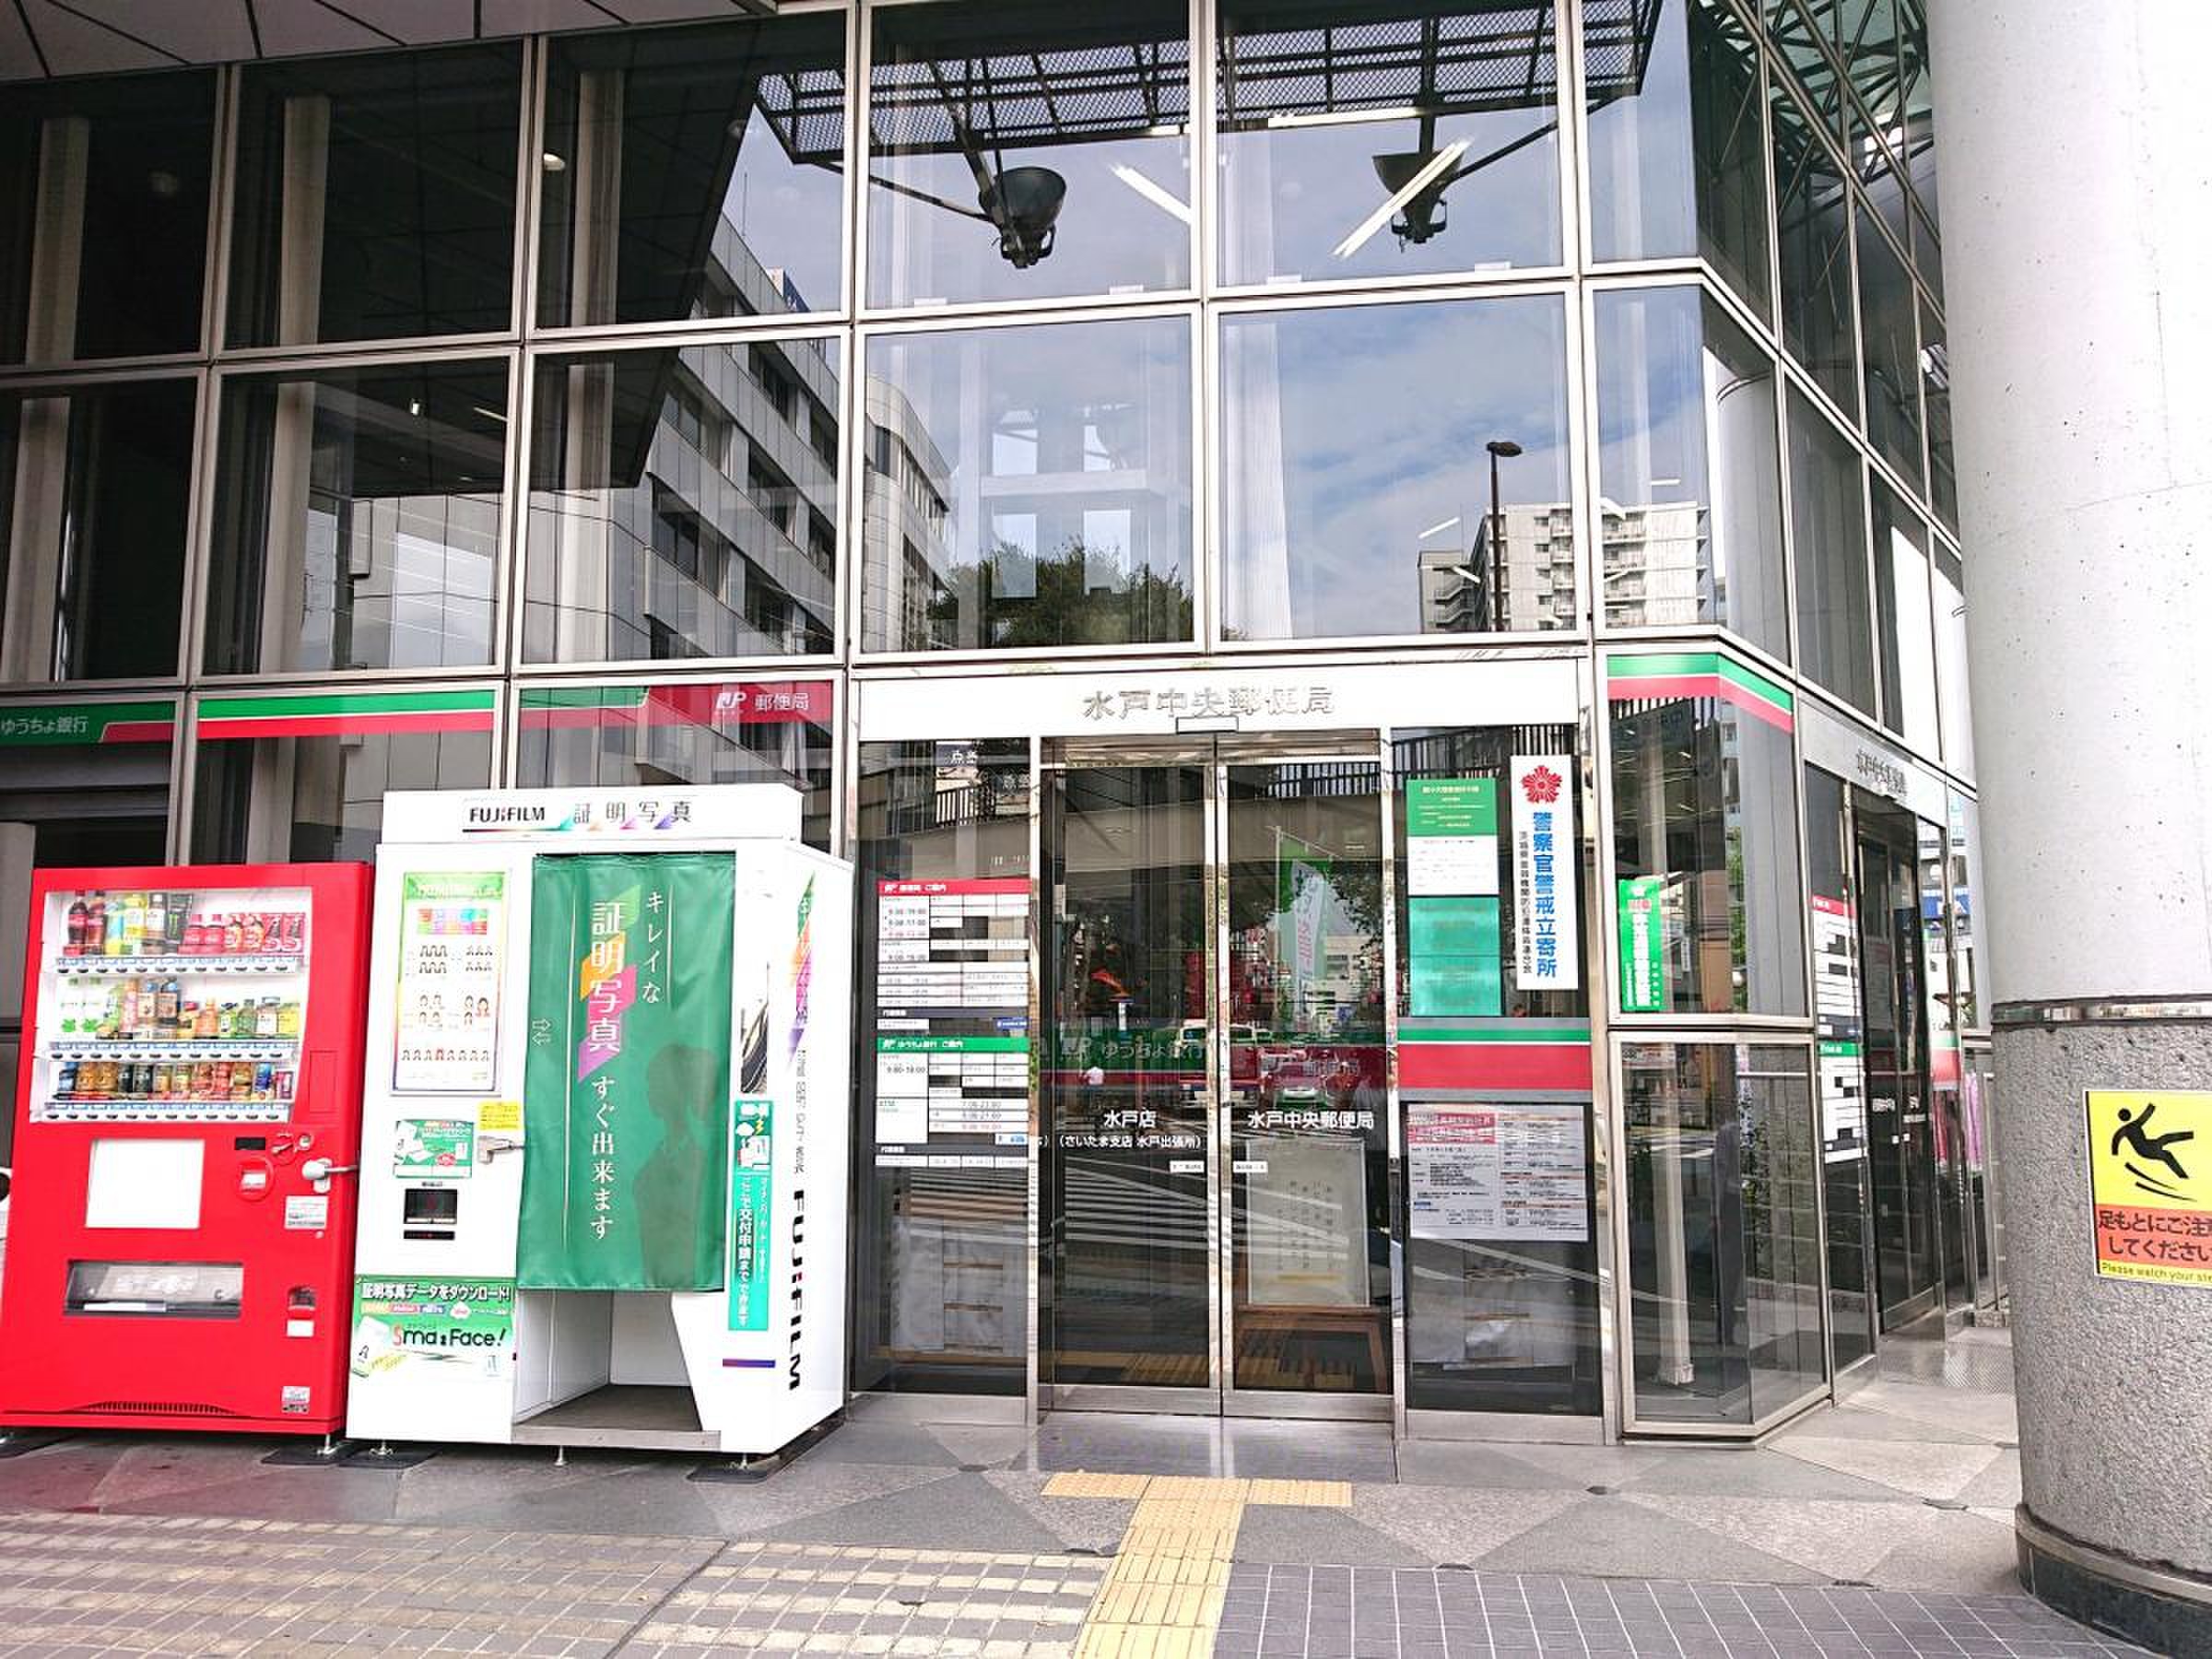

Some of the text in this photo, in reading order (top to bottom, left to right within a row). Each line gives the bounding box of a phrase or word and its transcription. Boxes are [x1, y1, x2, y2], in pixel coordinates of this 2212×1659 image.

[755, 692, 809, 712] 郵便局
[1083, 687, 1335, 720] 水戸中央郵便局
[1, 716, 88, 735] ゆうちょ銀行
[469, 800, 692, 824] FUJIFILM 証明写真
[1533, 812, 1557, 978] 警察官警戒立寄所
[642, 889, 665, 1004] キレイな
[588, 900, 626, 1054] 証明写真
[1103, 1110, 1157, 1129] 水戸店
[1247, 1111, 1374, 1129] 水戸中央郵便局
[589, 1076, 616, 1241] すぐ出来ます
[2099, 1210, 2212, 1237] 足もとにご注
[2102, 1262, 2134, 1274] Please
[2136, 1266, 2167, 1277] watch
[2170, 1271, 2194, 1282] your
[789, 1189, 805, 1391] FUJIFILM
